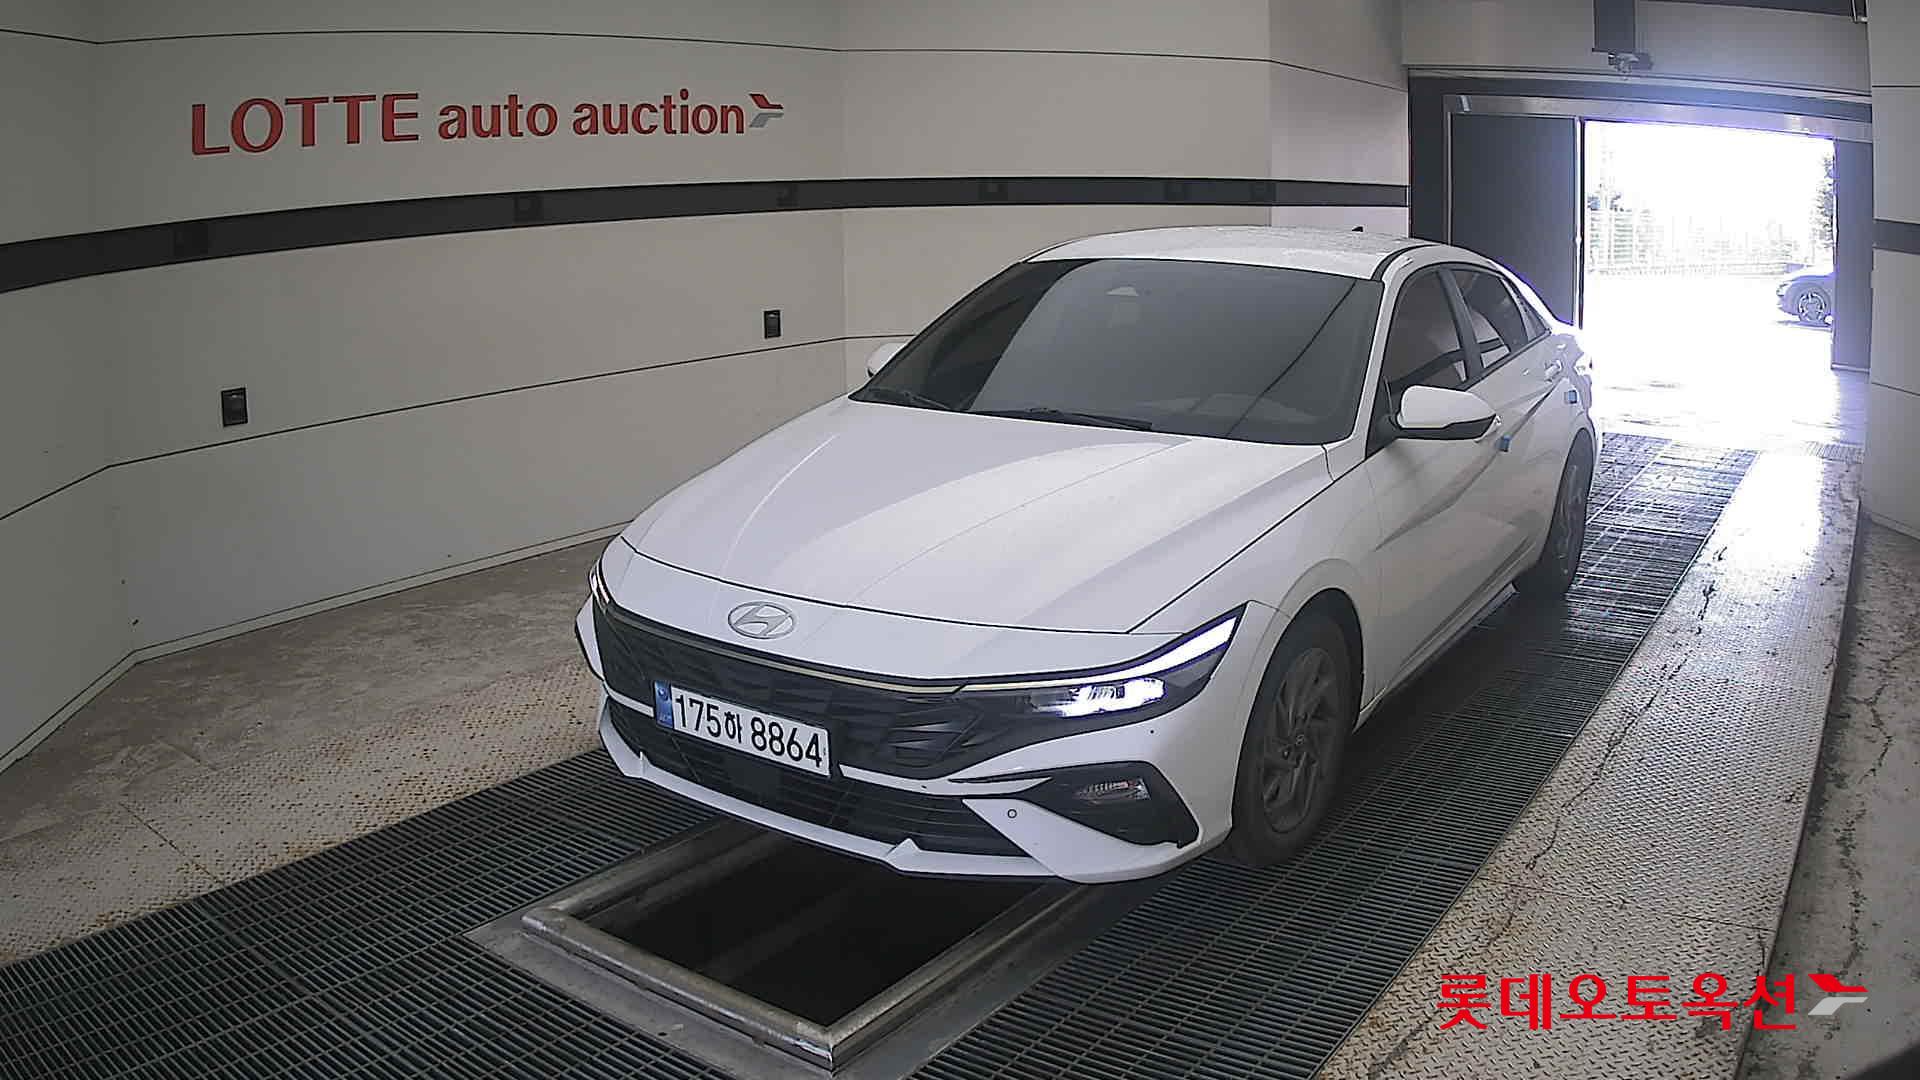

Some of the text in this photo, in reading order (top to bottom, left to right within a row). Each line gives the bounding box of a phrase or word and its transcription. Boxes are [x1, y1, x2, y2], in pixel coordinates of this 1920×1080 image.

[191, 88, 745, 156] LOTTE auto auction
[675, 695, 822, 768] 175하 8864
